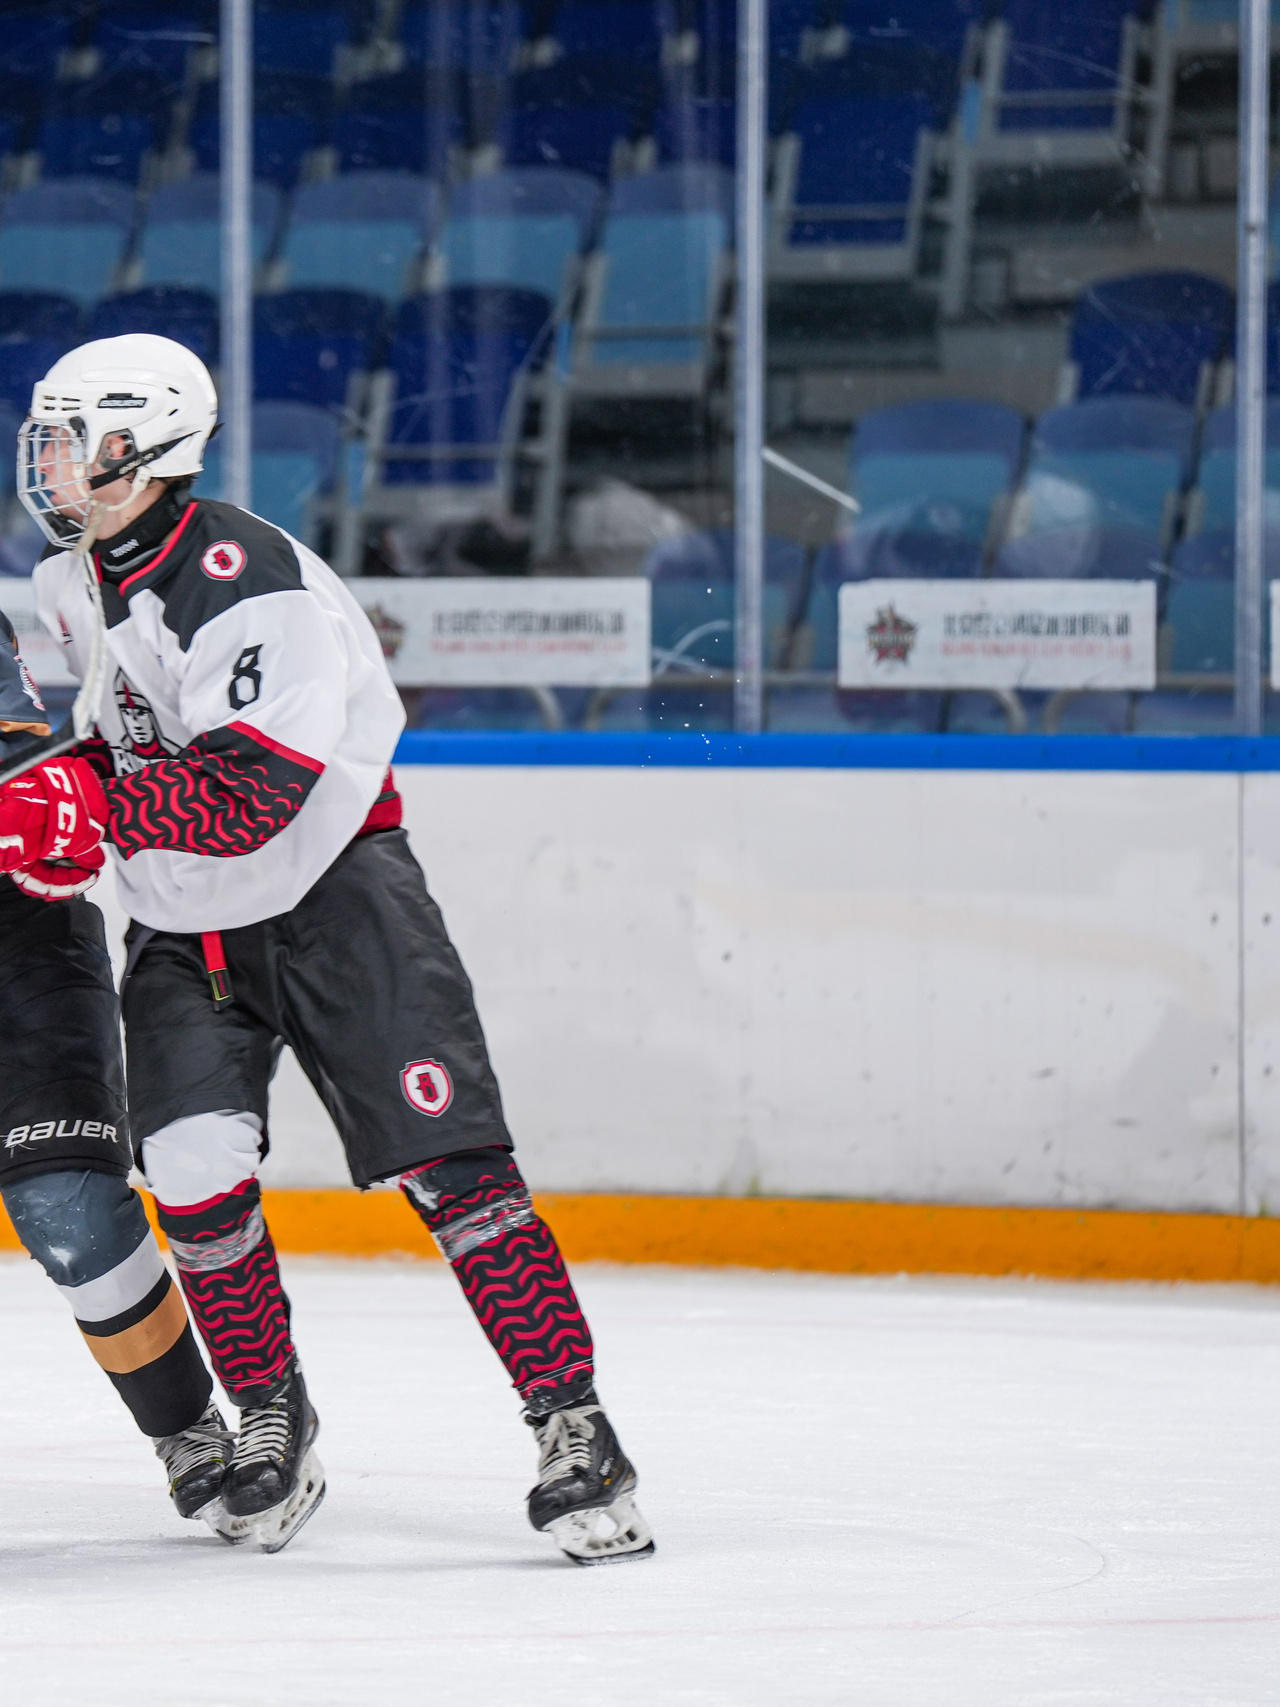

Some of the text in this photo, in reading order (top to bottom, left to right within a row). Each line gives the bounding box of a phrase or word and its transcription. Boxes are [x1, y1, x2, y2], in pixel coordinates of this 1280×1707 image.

[228, 643, 264, 711] 8
[43, 765, 77, 857] CCM
[4, 1119, 119, 1148] BAUER
